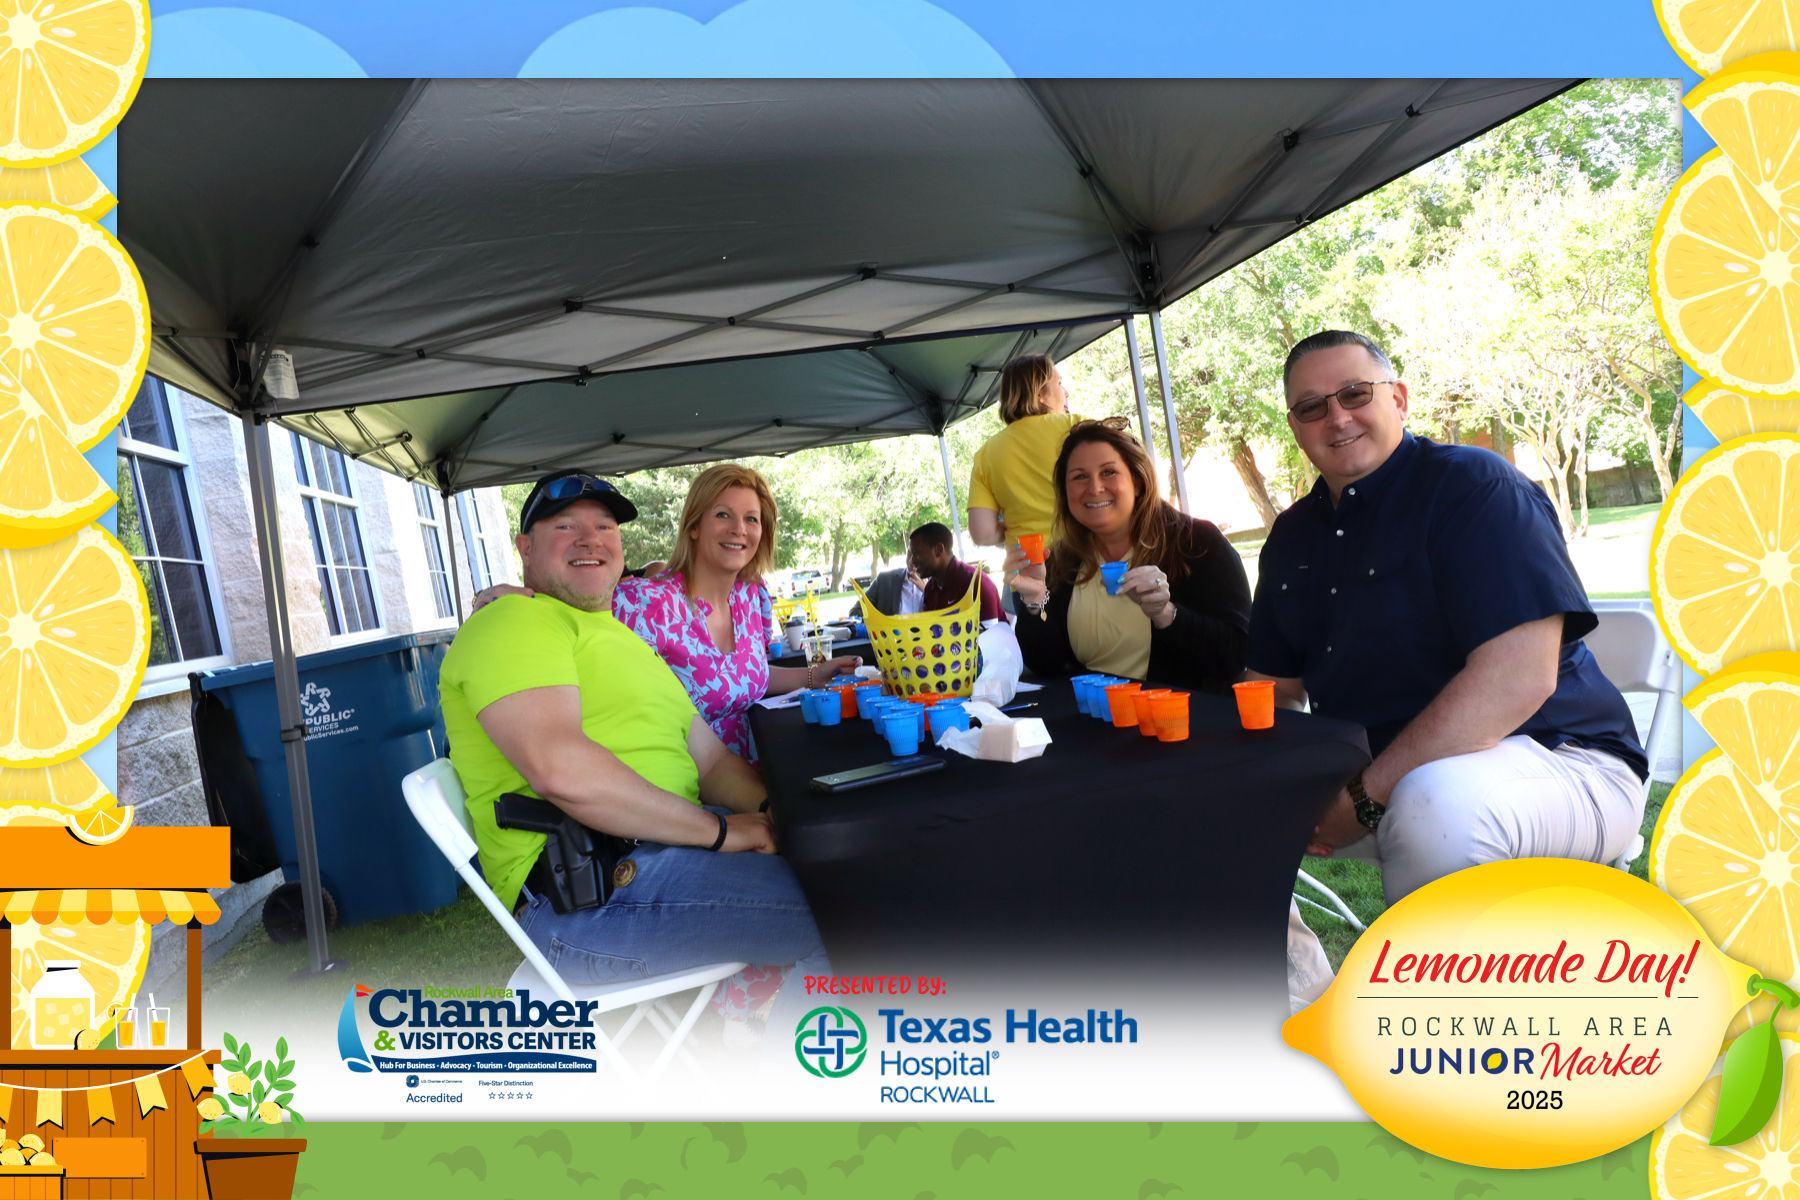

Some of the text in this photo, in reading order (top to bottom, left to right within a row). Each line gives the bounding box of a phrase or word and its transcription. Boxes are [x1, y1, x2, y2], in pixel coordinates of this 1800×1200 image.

[303, 709, 352, 726] PUBLIC
[304, 725, 359, 741] ublicServices.com
[309, 722, 339, 734] ERVICES
